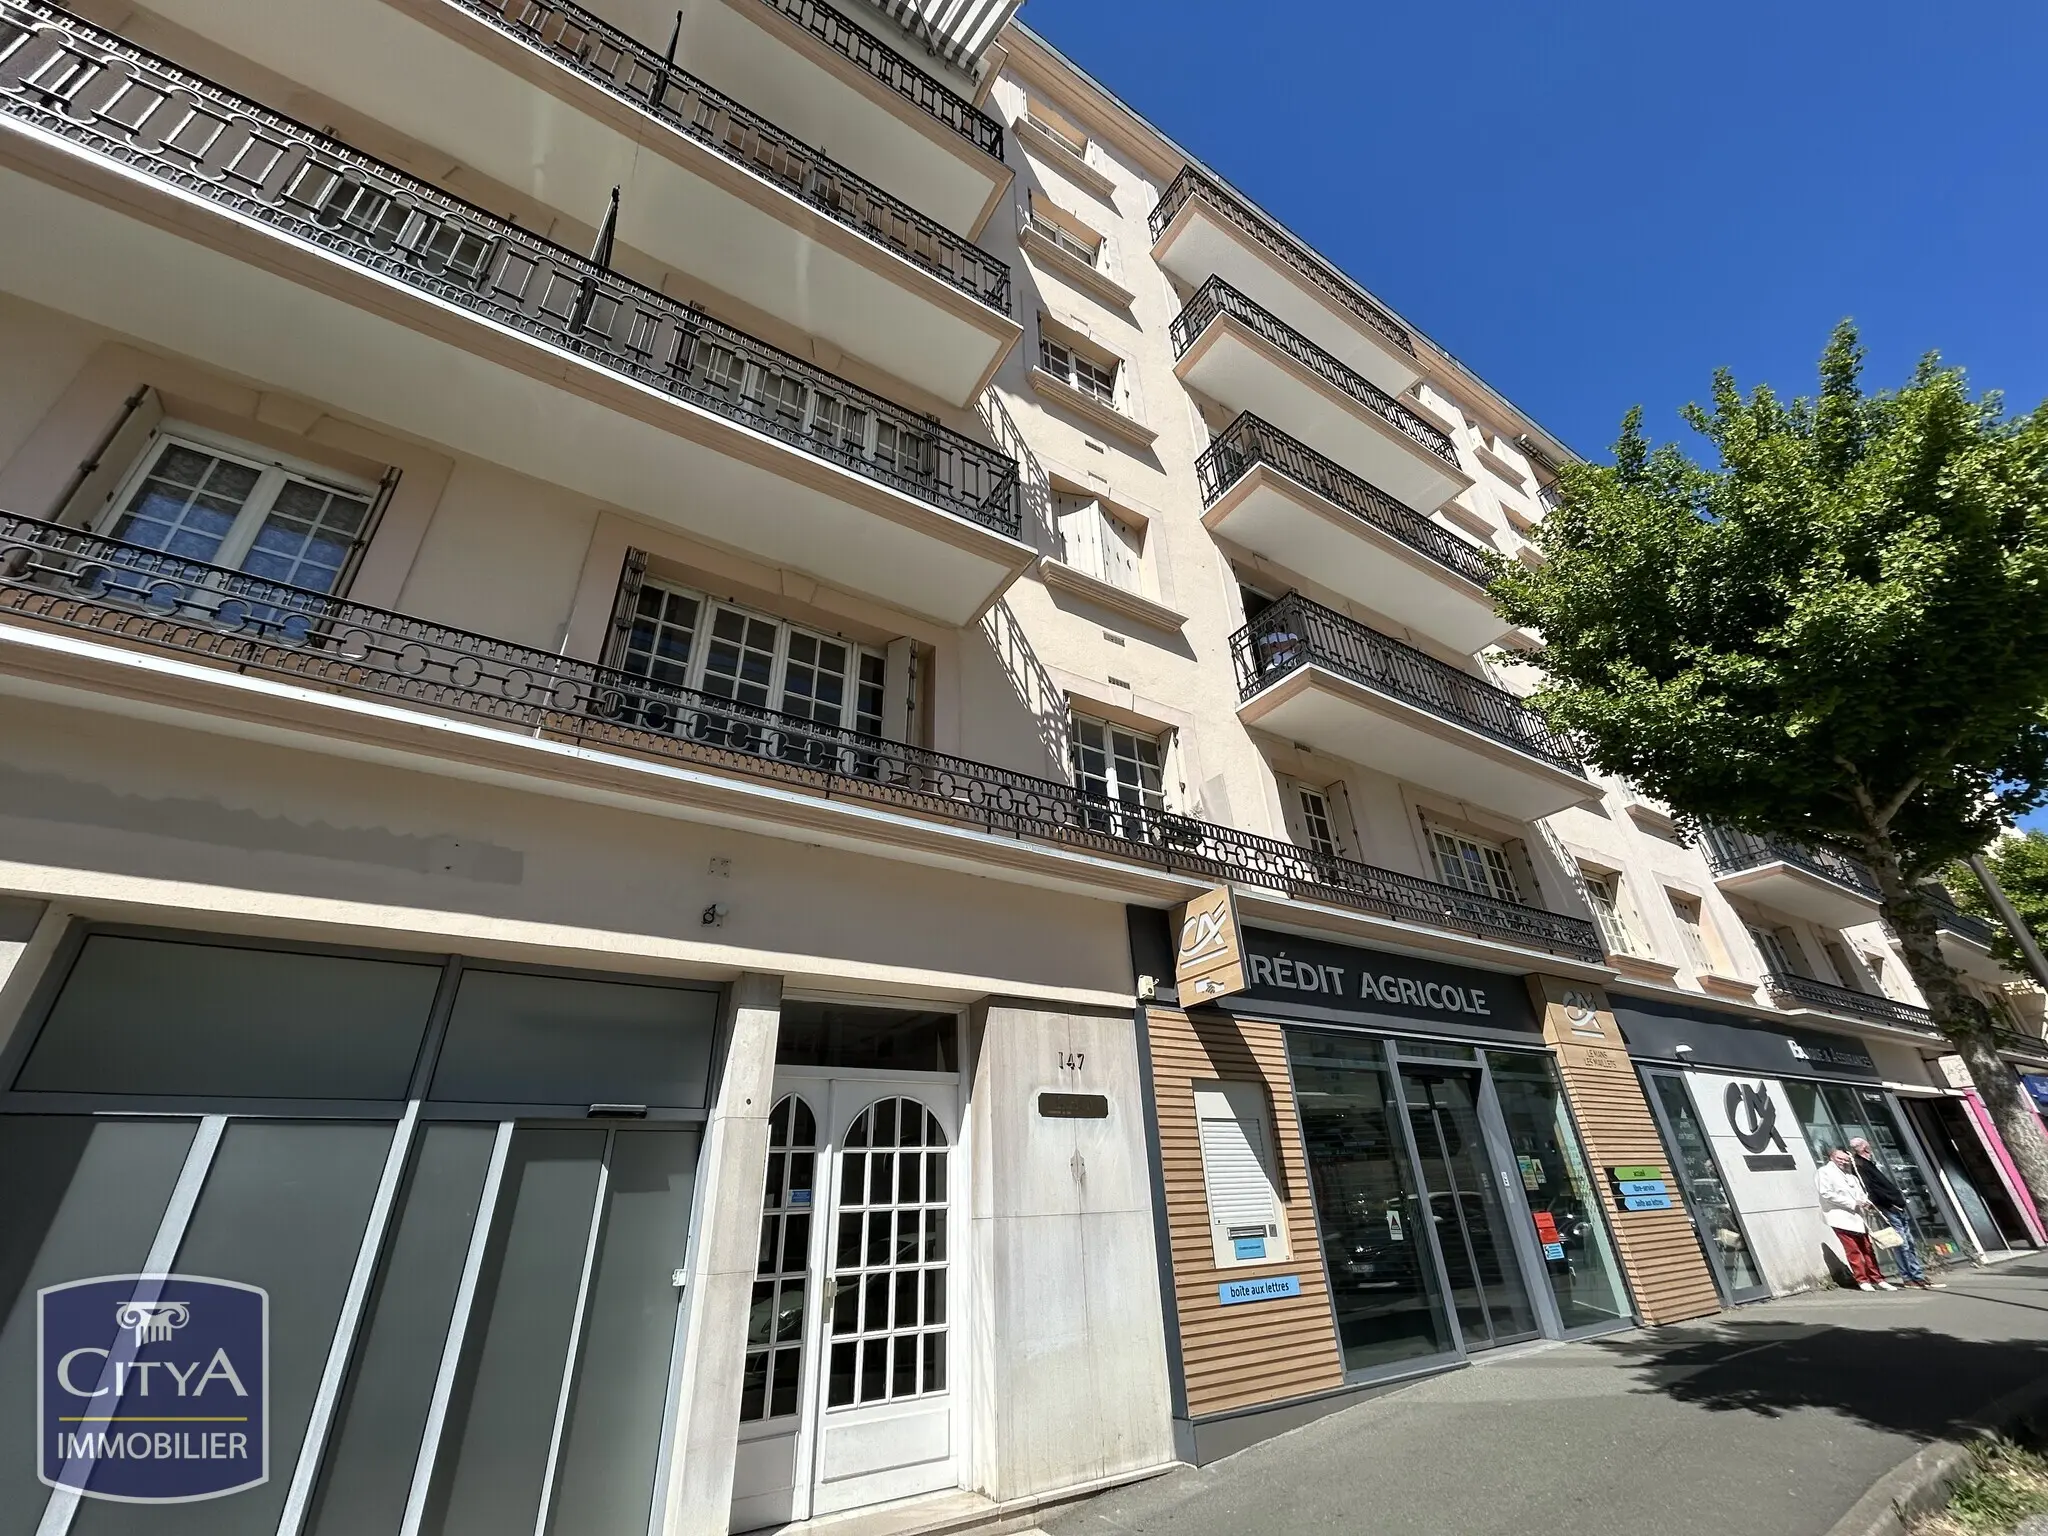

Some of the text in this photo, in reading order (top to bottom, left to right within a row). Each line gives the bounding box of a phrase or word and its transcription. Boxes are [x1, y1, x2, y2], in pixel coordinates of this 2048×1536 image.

[1249, 951, 1491, 1016] RÉDIT AGRICOLE
[1058, 1052, 1085, 1070] 147
[1230, 1281, 1290, 1298] boîte aux lettres
